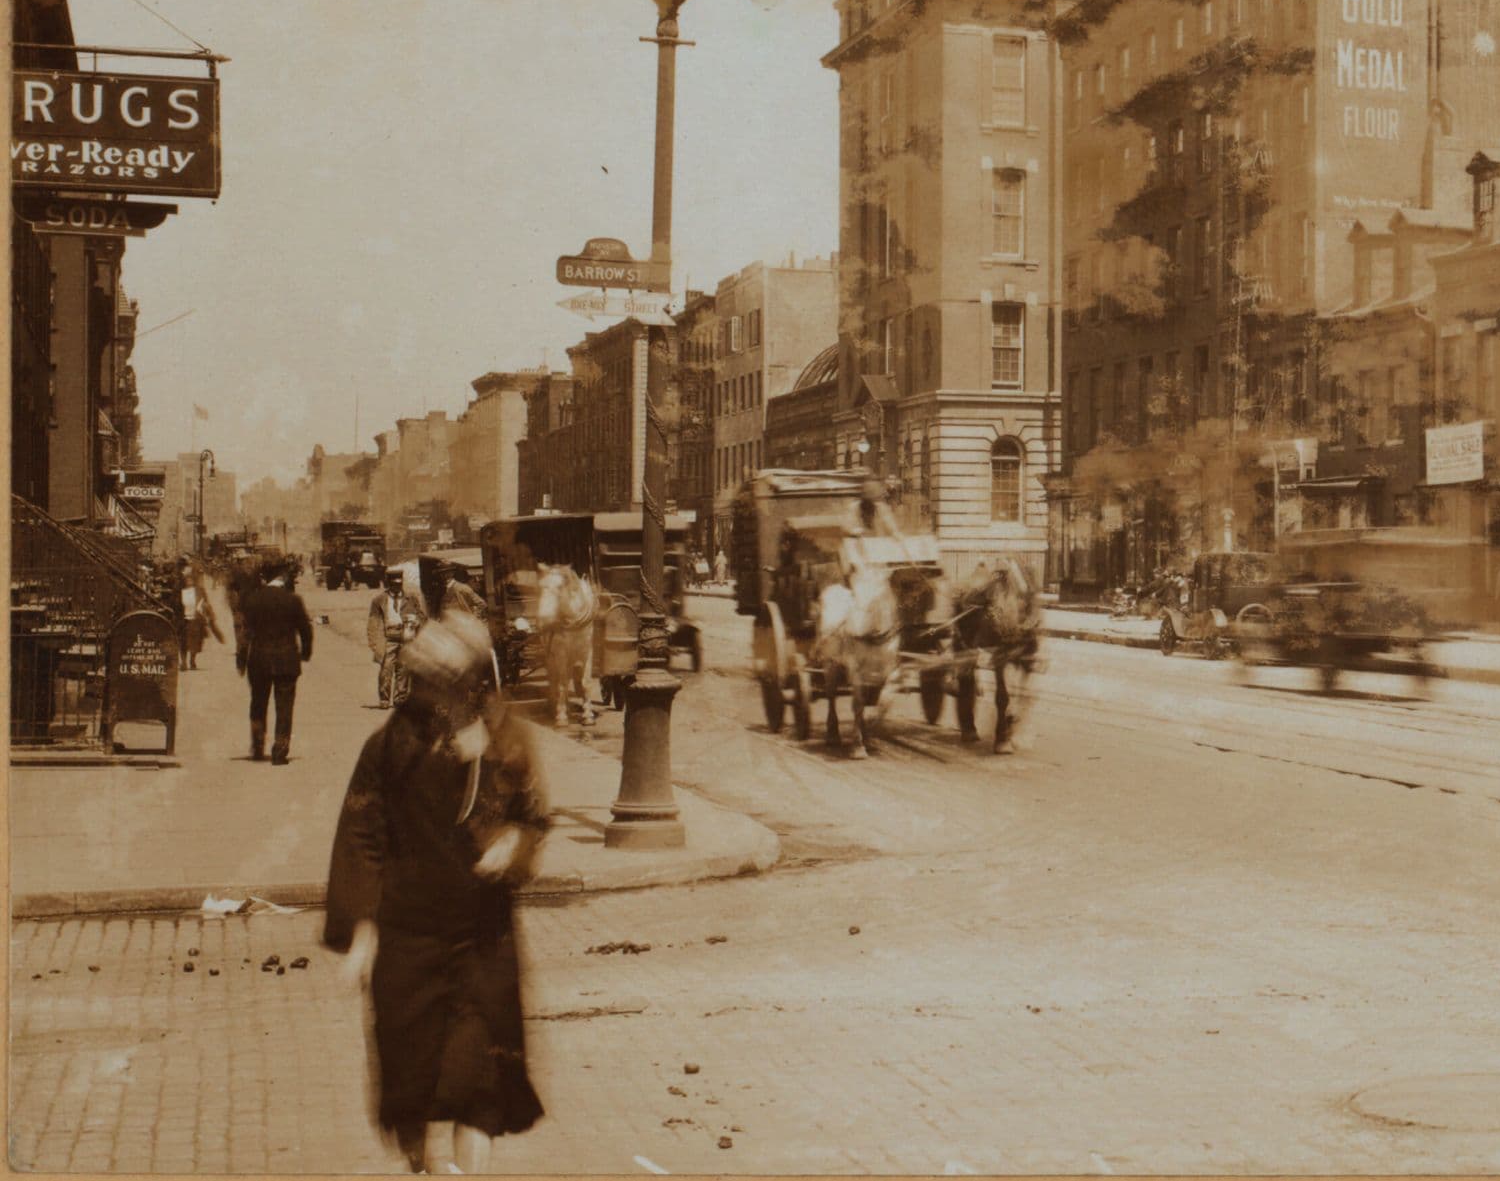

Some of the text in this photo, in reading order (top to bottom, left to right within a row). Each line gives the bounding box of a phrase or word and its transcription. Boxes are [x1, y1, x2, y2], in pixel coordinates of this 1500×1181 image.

[1336, 38, 1407, 92] MEDAL
[1343, 105, 1400, 141] FLOUR
[21, 162, 160, 178] RAZORS
[47, 206, 132, 230] SODA
[565, 265, 625, 280] BARROW
[126, 488, 163, 496] TOOLS
[142, 663, 168, 675] MAIL
